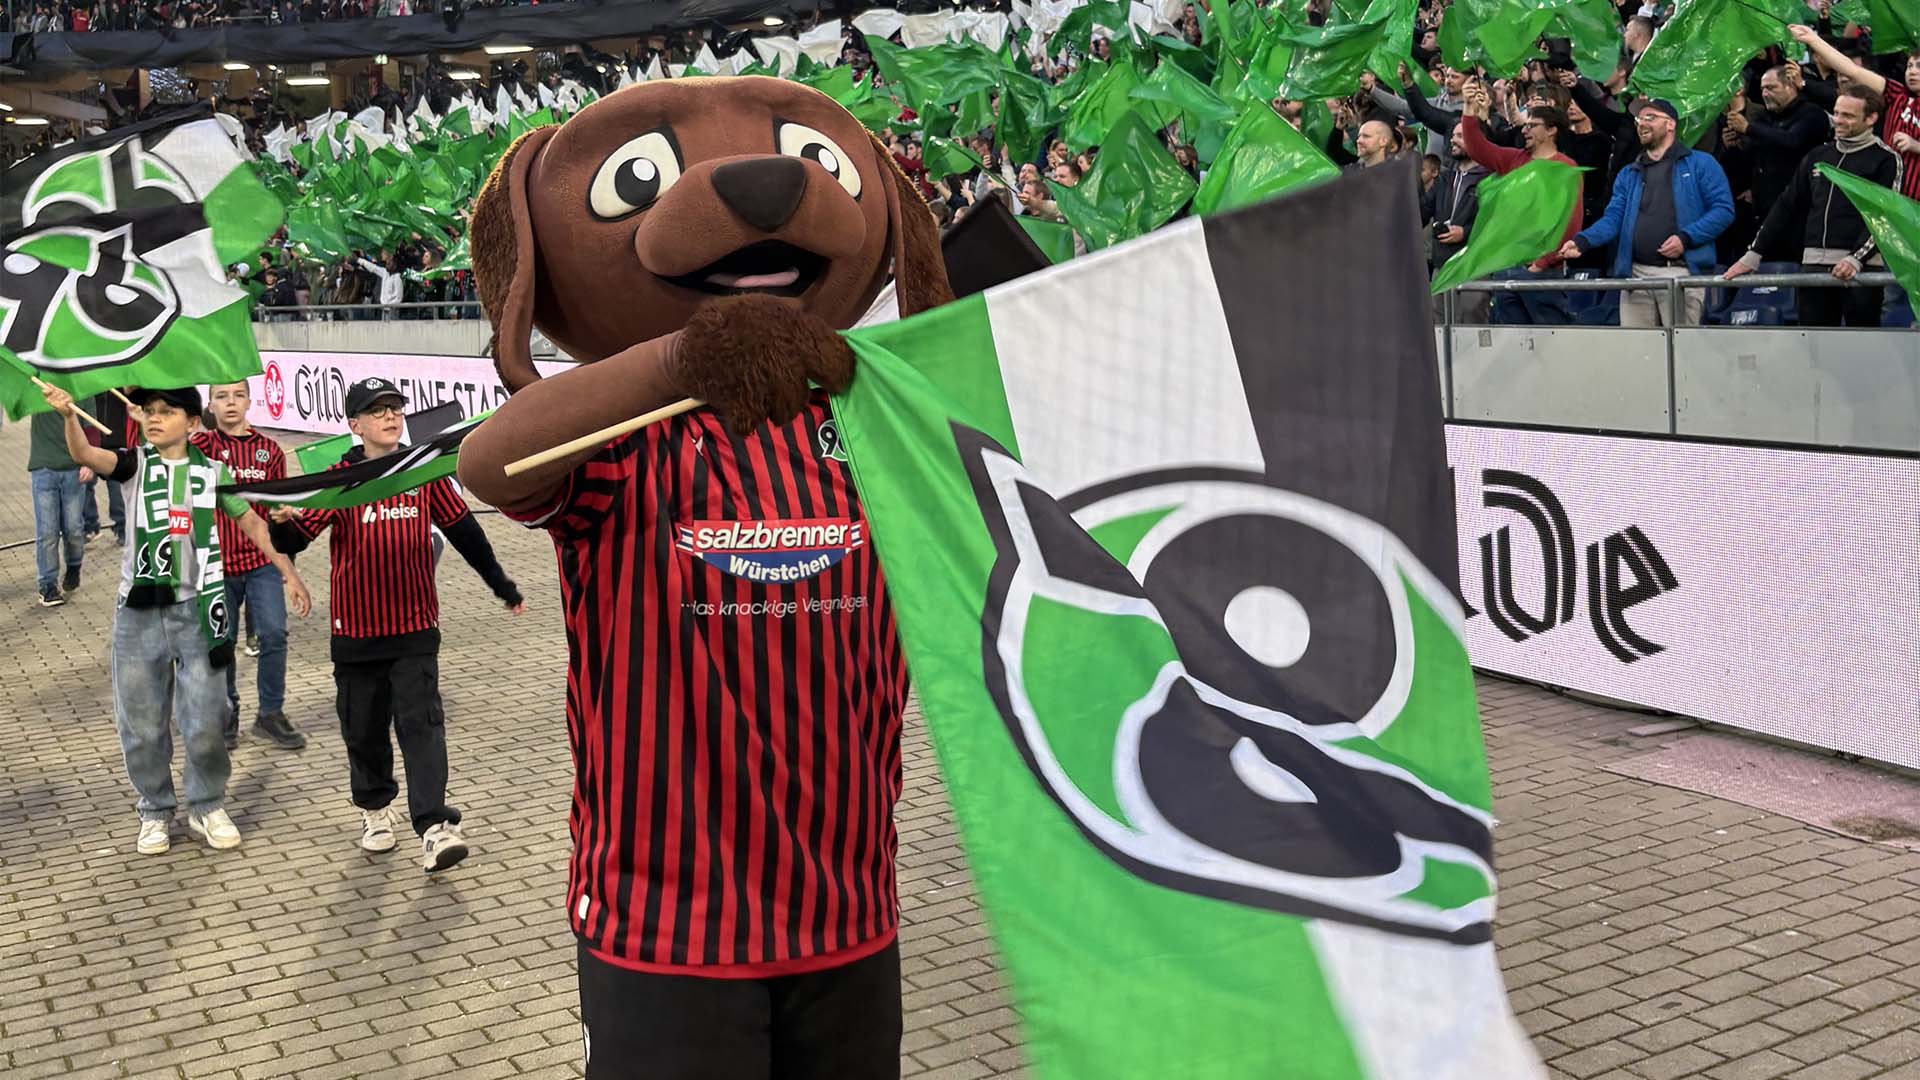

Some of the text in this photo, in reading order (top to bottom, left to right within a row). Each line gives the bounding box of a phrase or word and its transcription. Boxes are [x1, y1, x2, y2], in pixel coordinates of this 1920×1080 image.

[295, 364, 347, 423] Gild
[396, 378, 446, 412] EINE
[256, 450, 269, 461] 96
[380, 503, 419, 521] heise
[696, 522, 848, 549] salzbrenner
[729, 554, 830, 581] Würstchen
[718, 600, 798, 618] knackige
